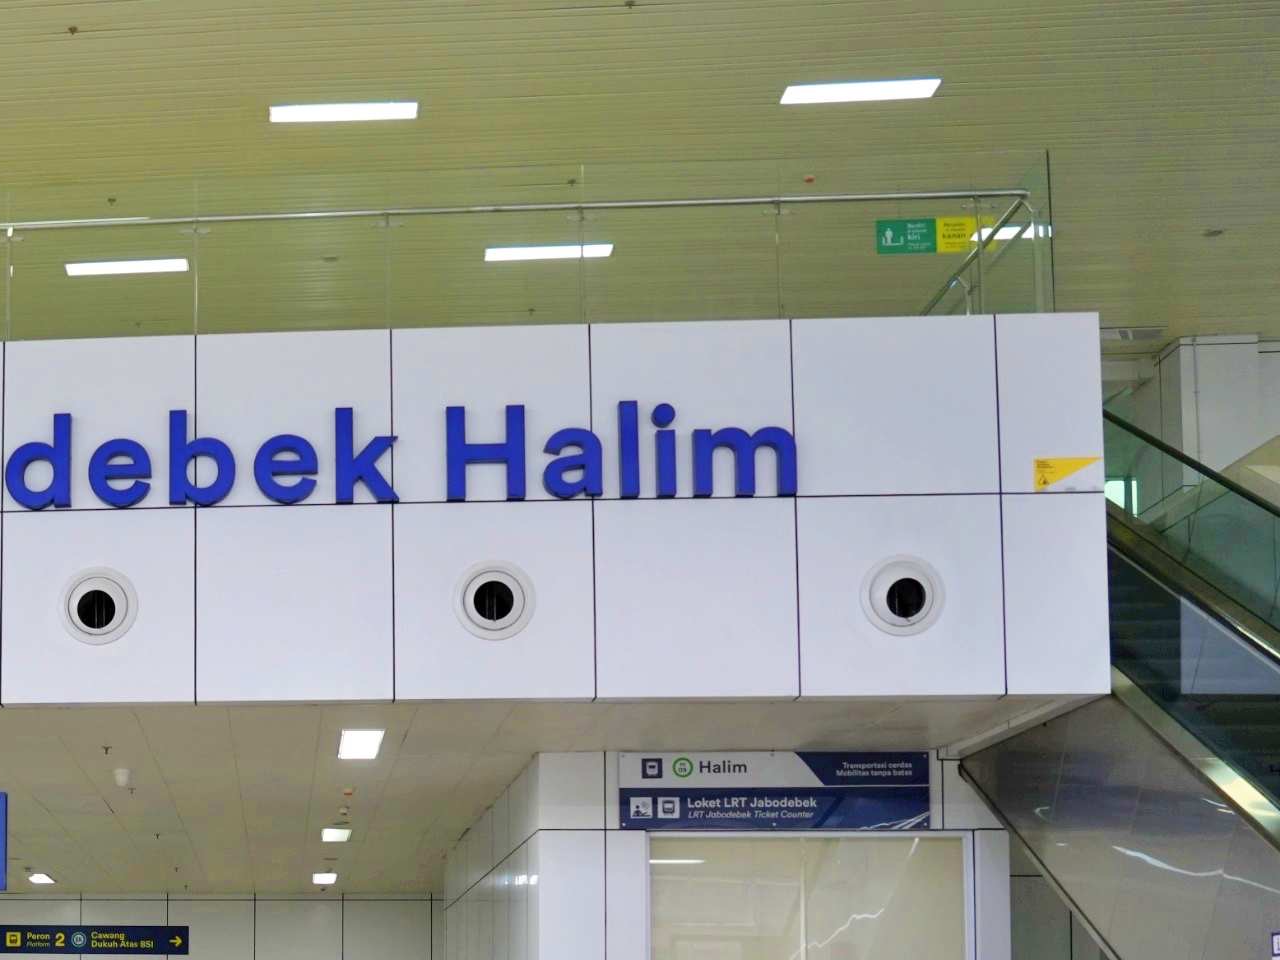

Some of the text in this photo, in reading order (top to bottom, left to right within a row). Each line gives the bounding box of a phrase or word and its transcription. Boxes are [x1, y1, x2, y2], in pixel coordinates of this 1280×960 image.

[446, 401, 797, 498] Halim
[699, 760, 748, 774] Halim
[687, 797, 817, 809] Loket LRT Jabodebek
[26, 931, 50, 940] Peron
[55, 932, 65, 947] 2
[90, 931, 125, 941] Cawang
[91, 940, 118, 948] Dukuh
[140, 941, 154, 949] BSI
